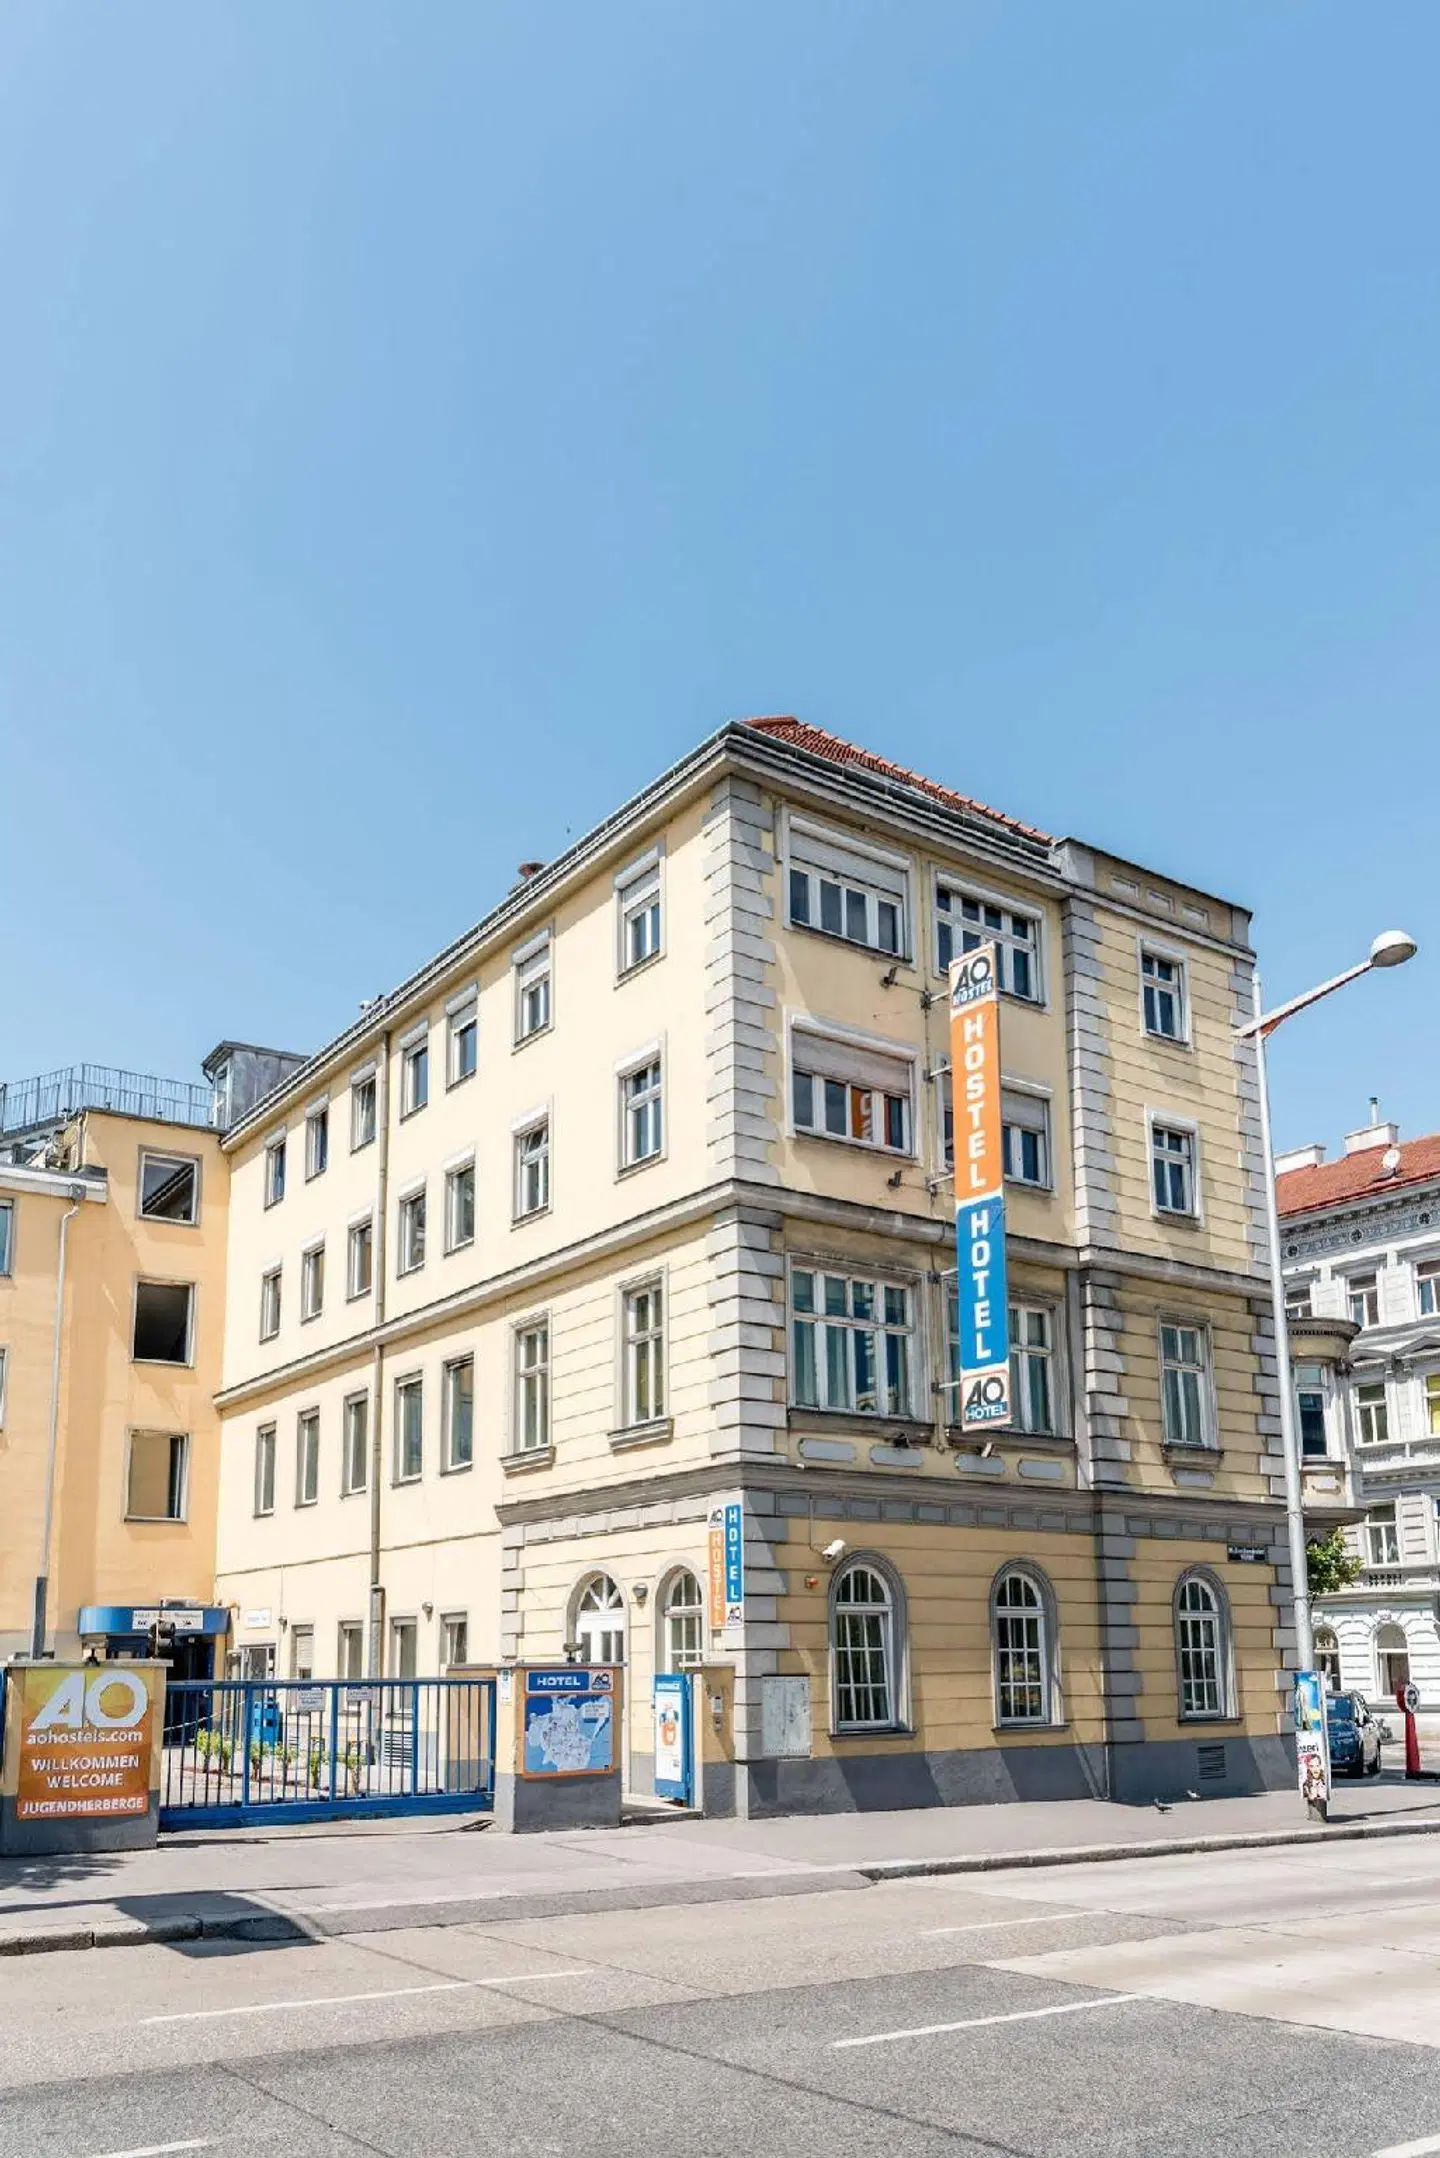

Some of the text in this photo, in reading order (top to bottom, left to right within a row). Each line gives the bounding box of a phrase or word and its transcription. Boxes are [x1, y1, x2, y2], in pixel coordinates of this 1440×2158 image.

[953, 956, 991, 995] AO
[952, 977, 992, 1006] HOSTEL
[964, 1013, 987, 1188] HOSTEL
[970, 1209, 991, 1360] HOTEL
[965, 1404, 1008, 1420] HOTEL
[728, 1508, 739, 1600] HOTEL
[536, 1676, 581, 1686] HOTEL
[27, 1670, 148, 1730] AO
[26, 1730, 143, 1745] aohostels.com
[31, 1755, 139, 1771] WILLKOMMEN
[46, 1773, 124, 1788] WELCOME
[22, 1797, 144, 1815] JUGENDHERBERGE
